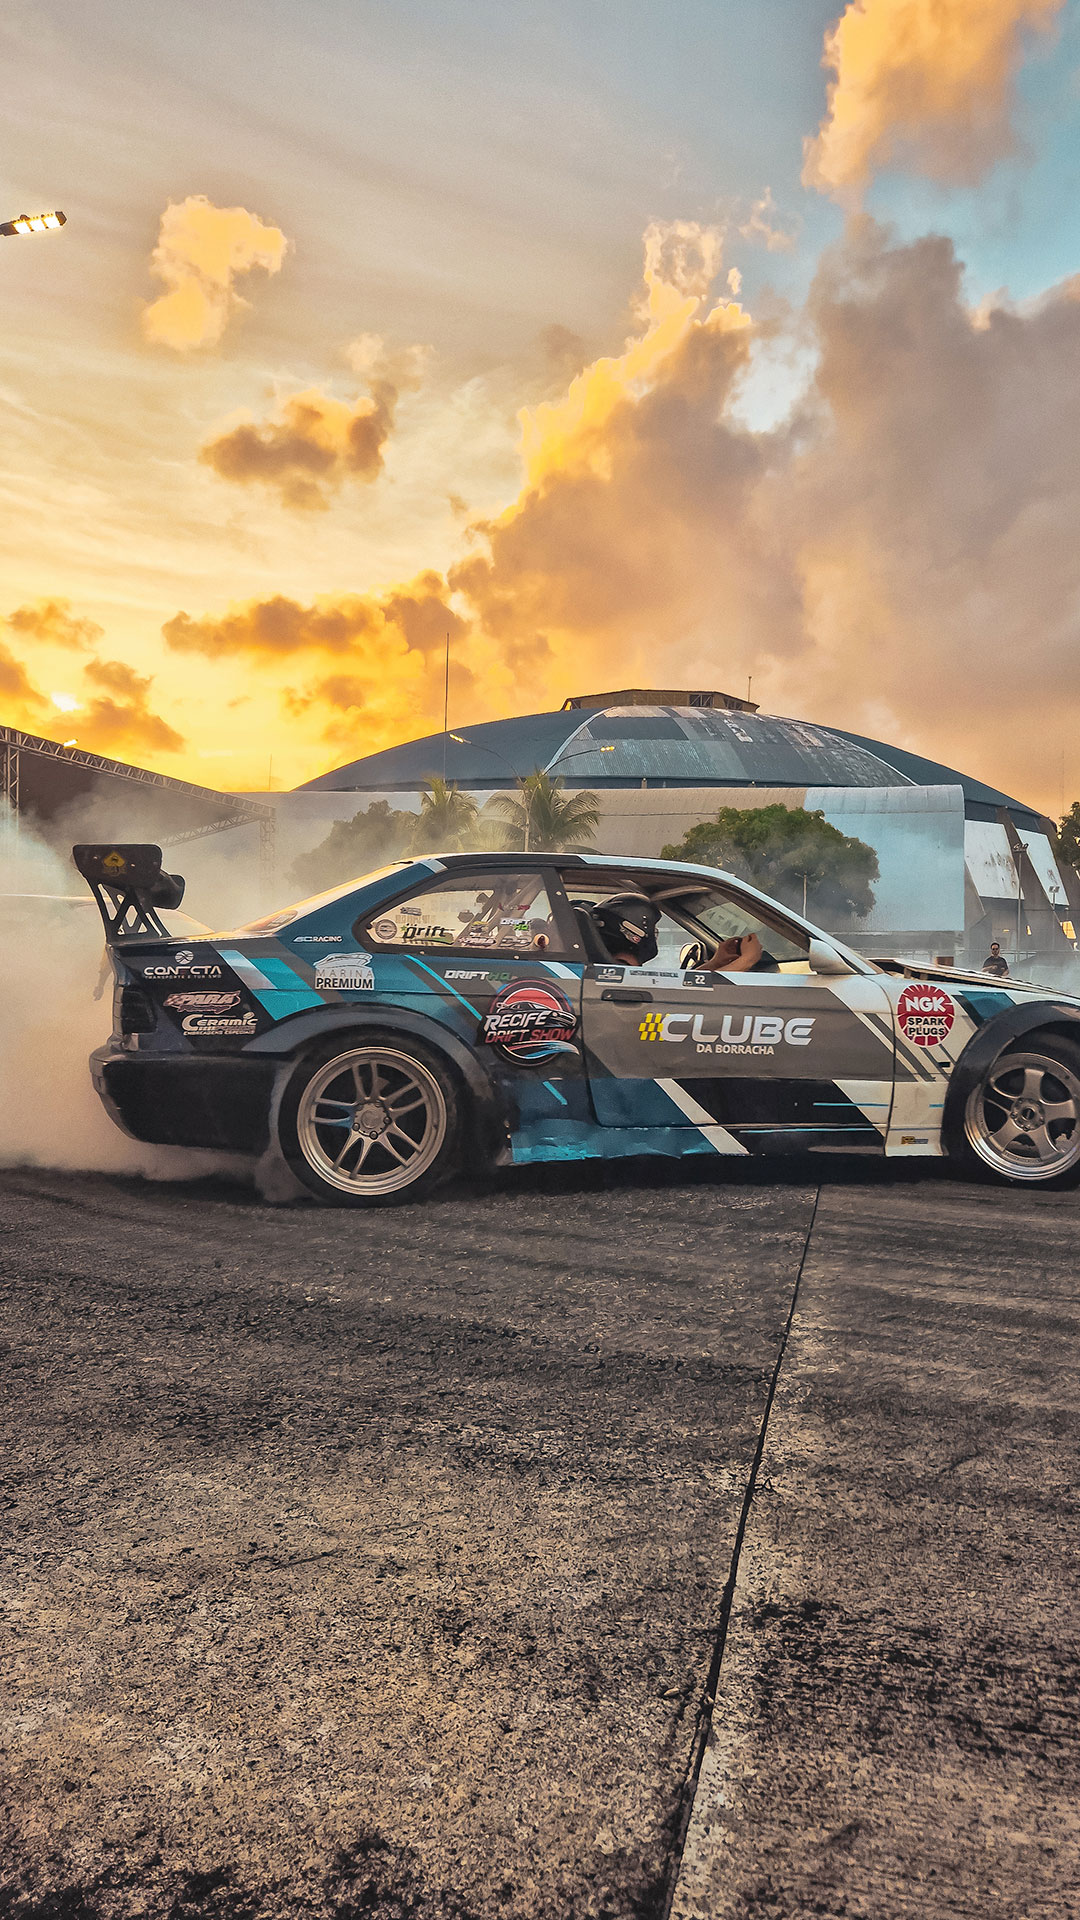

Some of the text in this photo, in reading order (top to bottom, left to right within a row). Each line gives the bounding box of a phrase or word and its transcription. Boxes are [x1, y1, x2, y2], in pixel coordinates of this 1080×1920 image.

[316, 969, 373, 978] MARINA
[316, 978, 373, 989] PREMIUM
[694, 975, 706, 985] 22
[905, 997, 946, 1012] NGK
[484, 1011, 551, 1031] RECIFE
[907, 1016, 946, 1027] SPARK
[661, 1013, 816, 1046] CLUBE
[908, 1026, 945, 1037] PLUGS
[485, 1028, 576, 1044] DRIFT SHOW
[696, 1043, 775, 1055] DA BORRACHA
